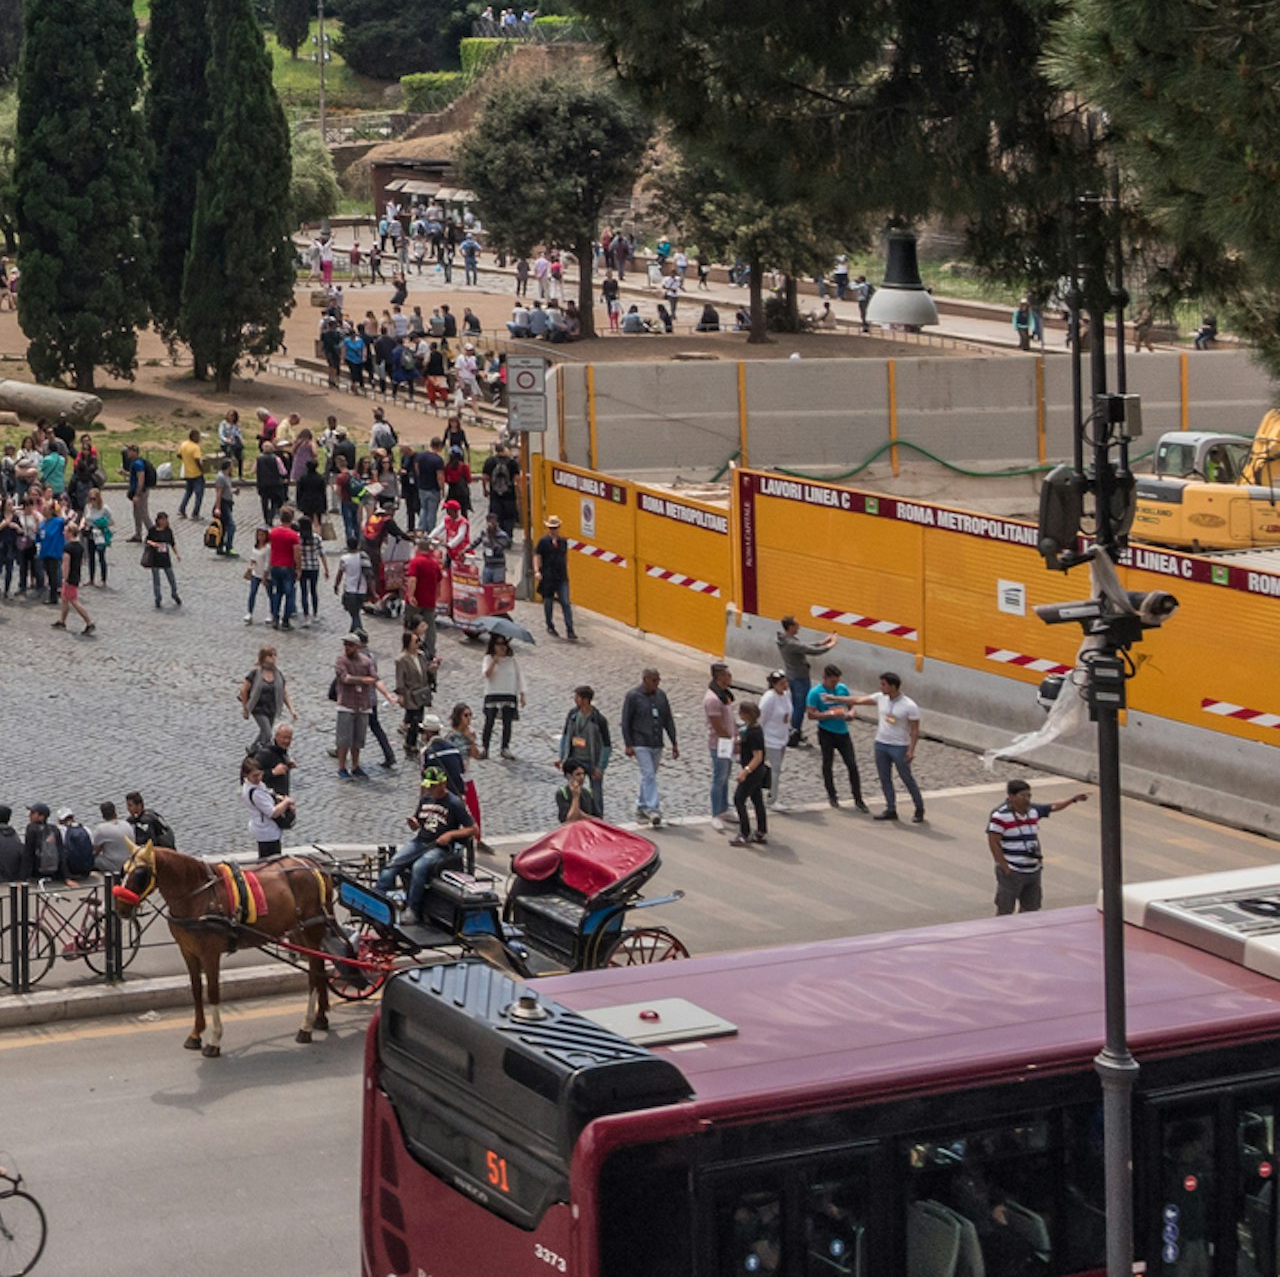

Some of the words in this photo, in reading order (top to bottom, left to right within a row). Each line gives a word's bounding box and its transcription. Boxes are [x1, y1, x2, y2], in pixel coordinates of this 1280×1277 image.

[599, 481, 606, 497] C
[760, 477, 802, 500] LAVORI
[804, 486, 839, 507] LINEA
[841, 492, 850, 509] C
[642, 494, 665, 514] ROMA
[666, 500, 727, 533] METROPOLITANE
[896, 502, 934, 525] ROMA
[1136, 550, 1179, 575] LINEA
[1181, 559, 1193, 578] C
[486, 1149, 510, 1193] 51
[534, 1243, 567, 1273] 3373
